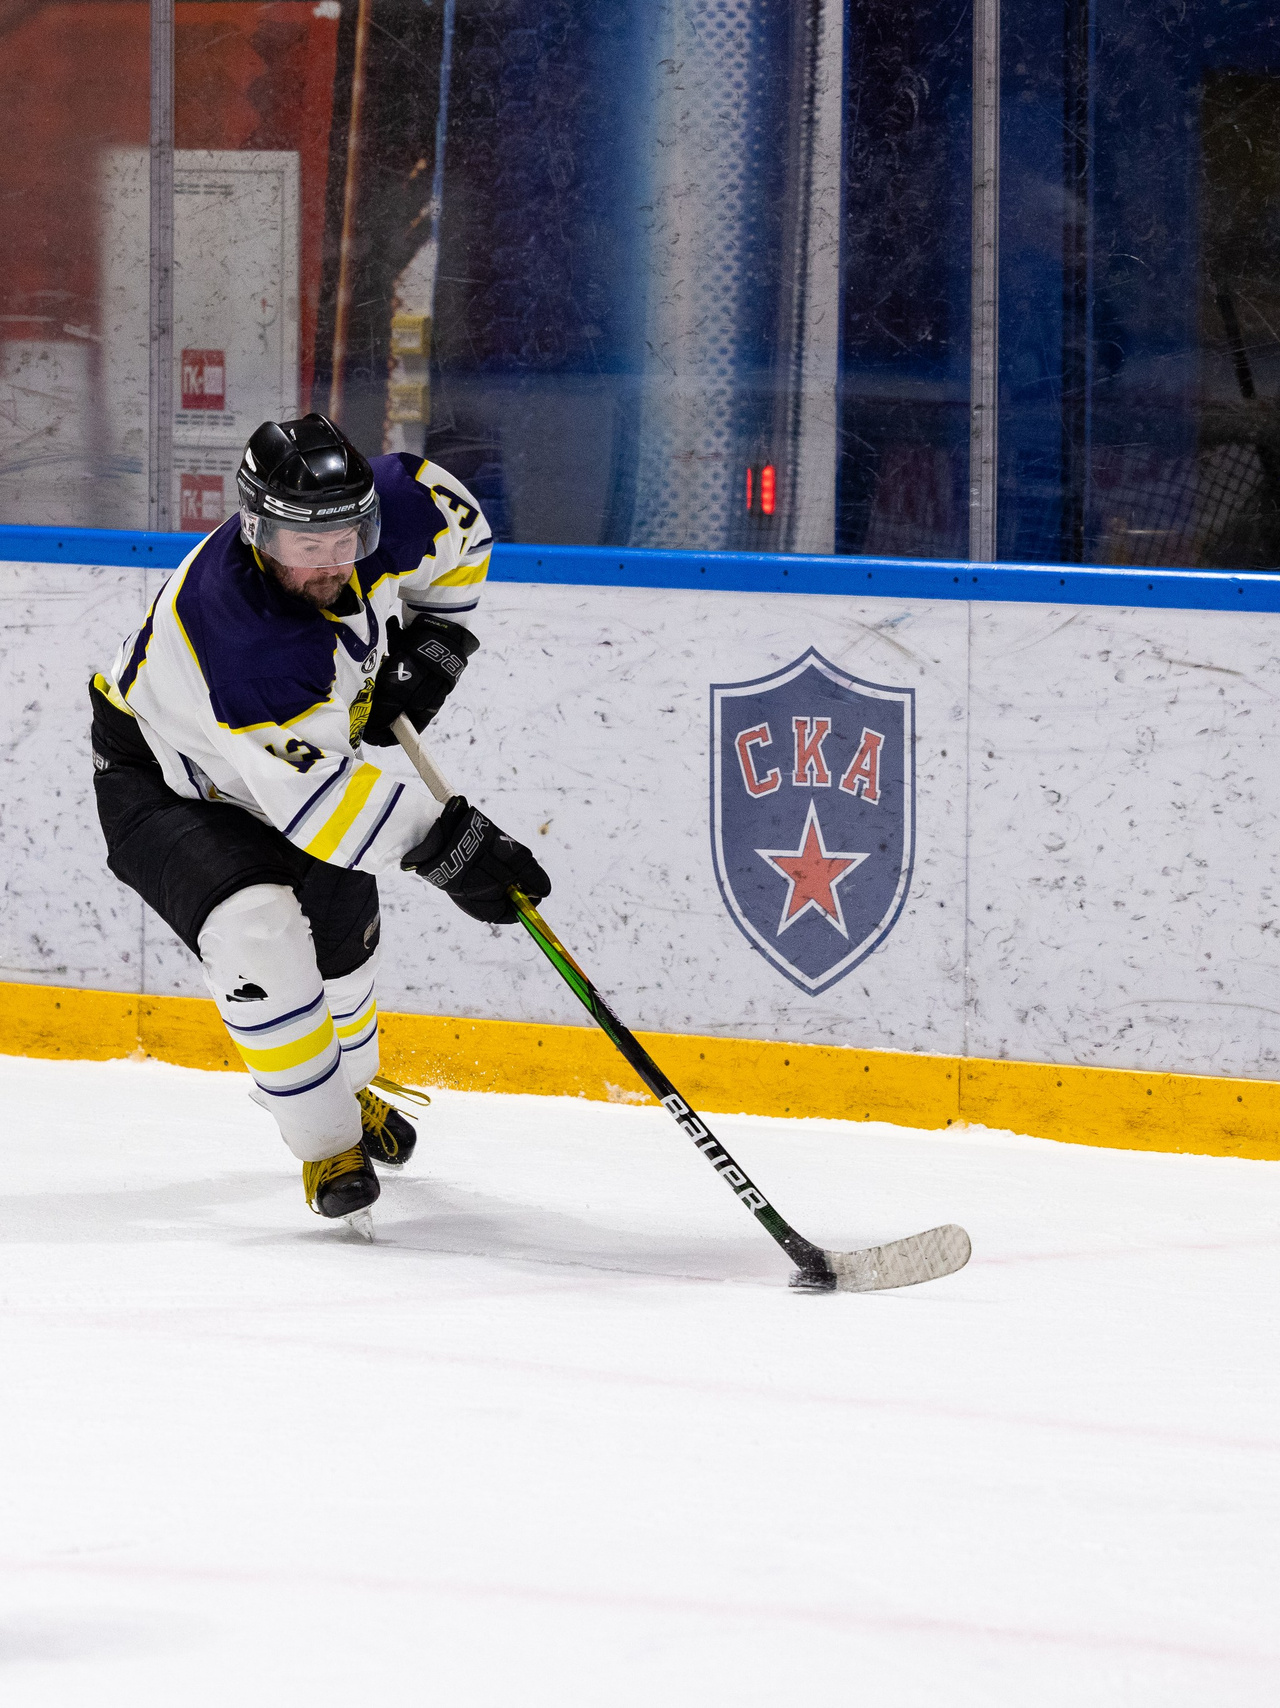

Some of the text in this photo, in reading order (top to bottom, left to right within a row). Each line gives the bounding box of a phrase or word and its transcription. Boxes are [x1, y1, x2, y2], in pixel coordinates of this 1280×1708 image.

[316, 502, 357, 516] BAUER
[734, 716, 886, 806] СКА
[422, 810, 490, 887] AUER
[661, 1093, 768, 1216] BAUER
